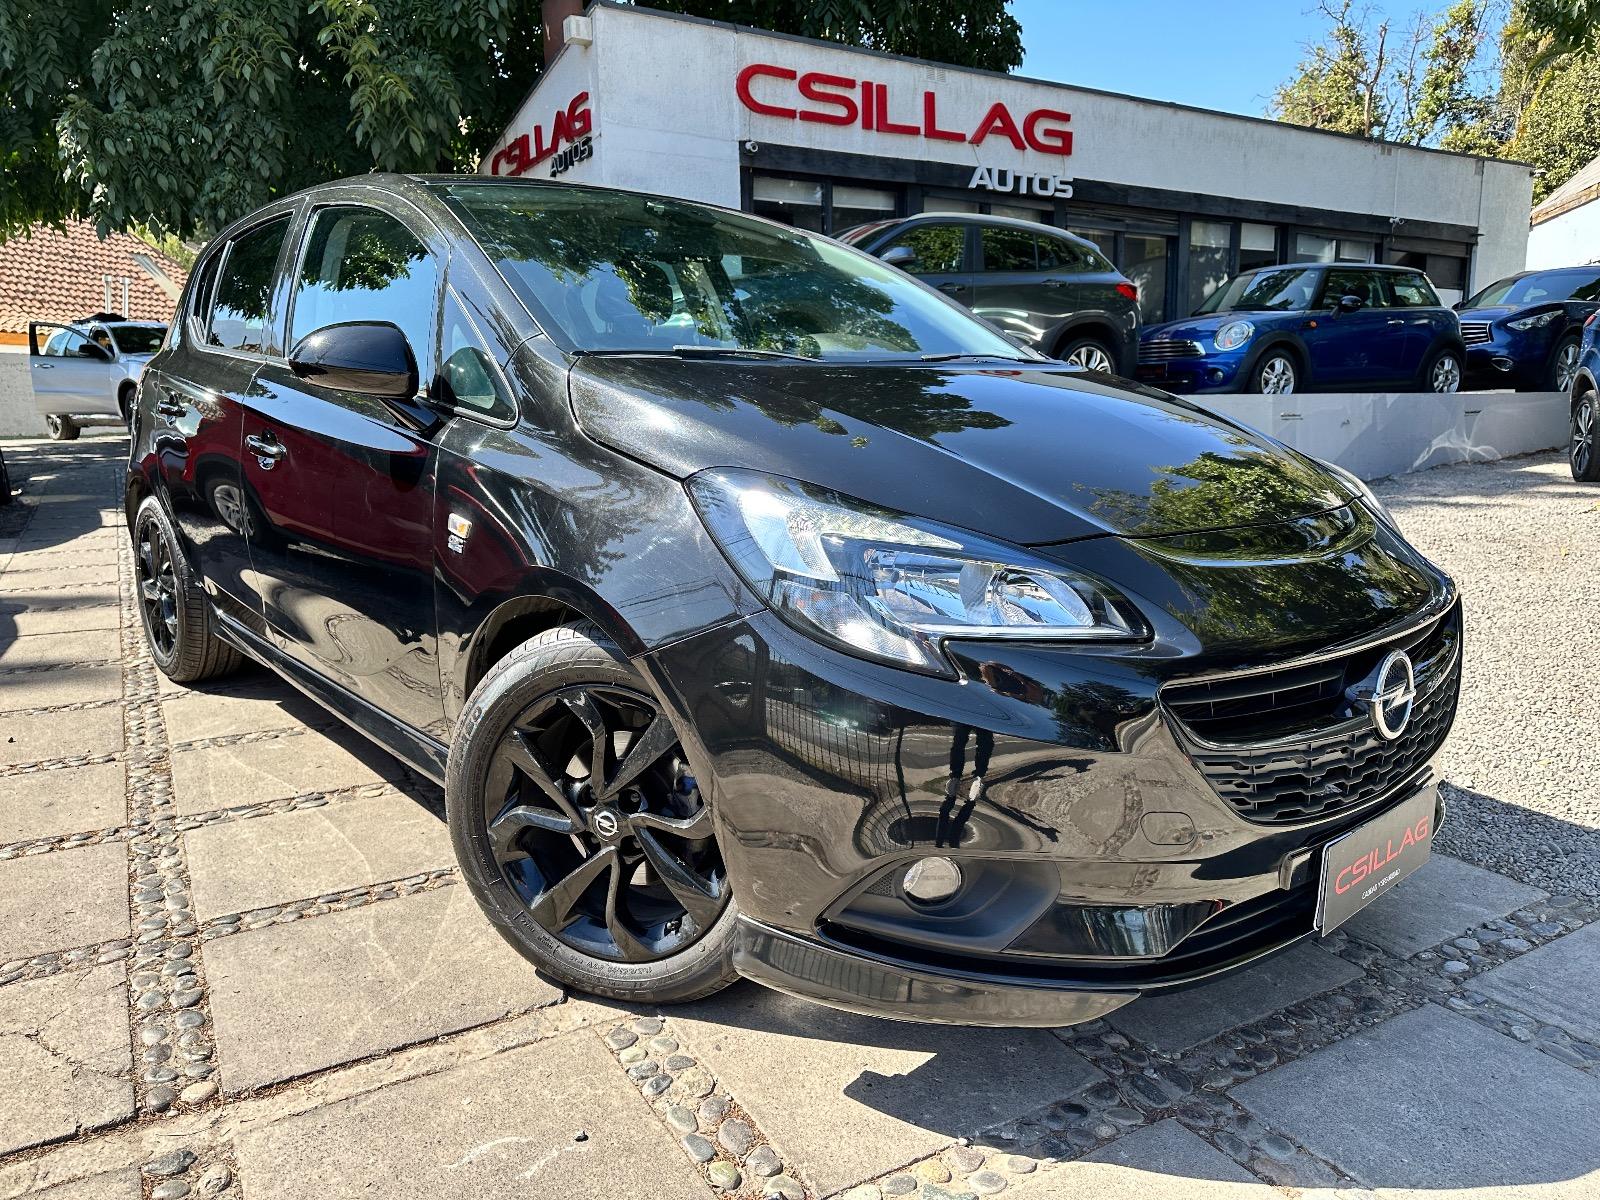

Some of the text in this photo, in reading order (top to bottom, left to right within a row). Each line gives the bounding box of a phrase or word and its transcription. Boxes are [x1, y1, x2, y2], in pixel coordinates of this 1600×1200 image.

[491, 91, 592, 177] CSILLAG
[736, 63, 1073, 156] CSILLAG
[550, 136, 594, 178] AUTOS
[968, 166, 1074, 199] AUTOS
[1334, 815, 1429, 895] CSILLAG
